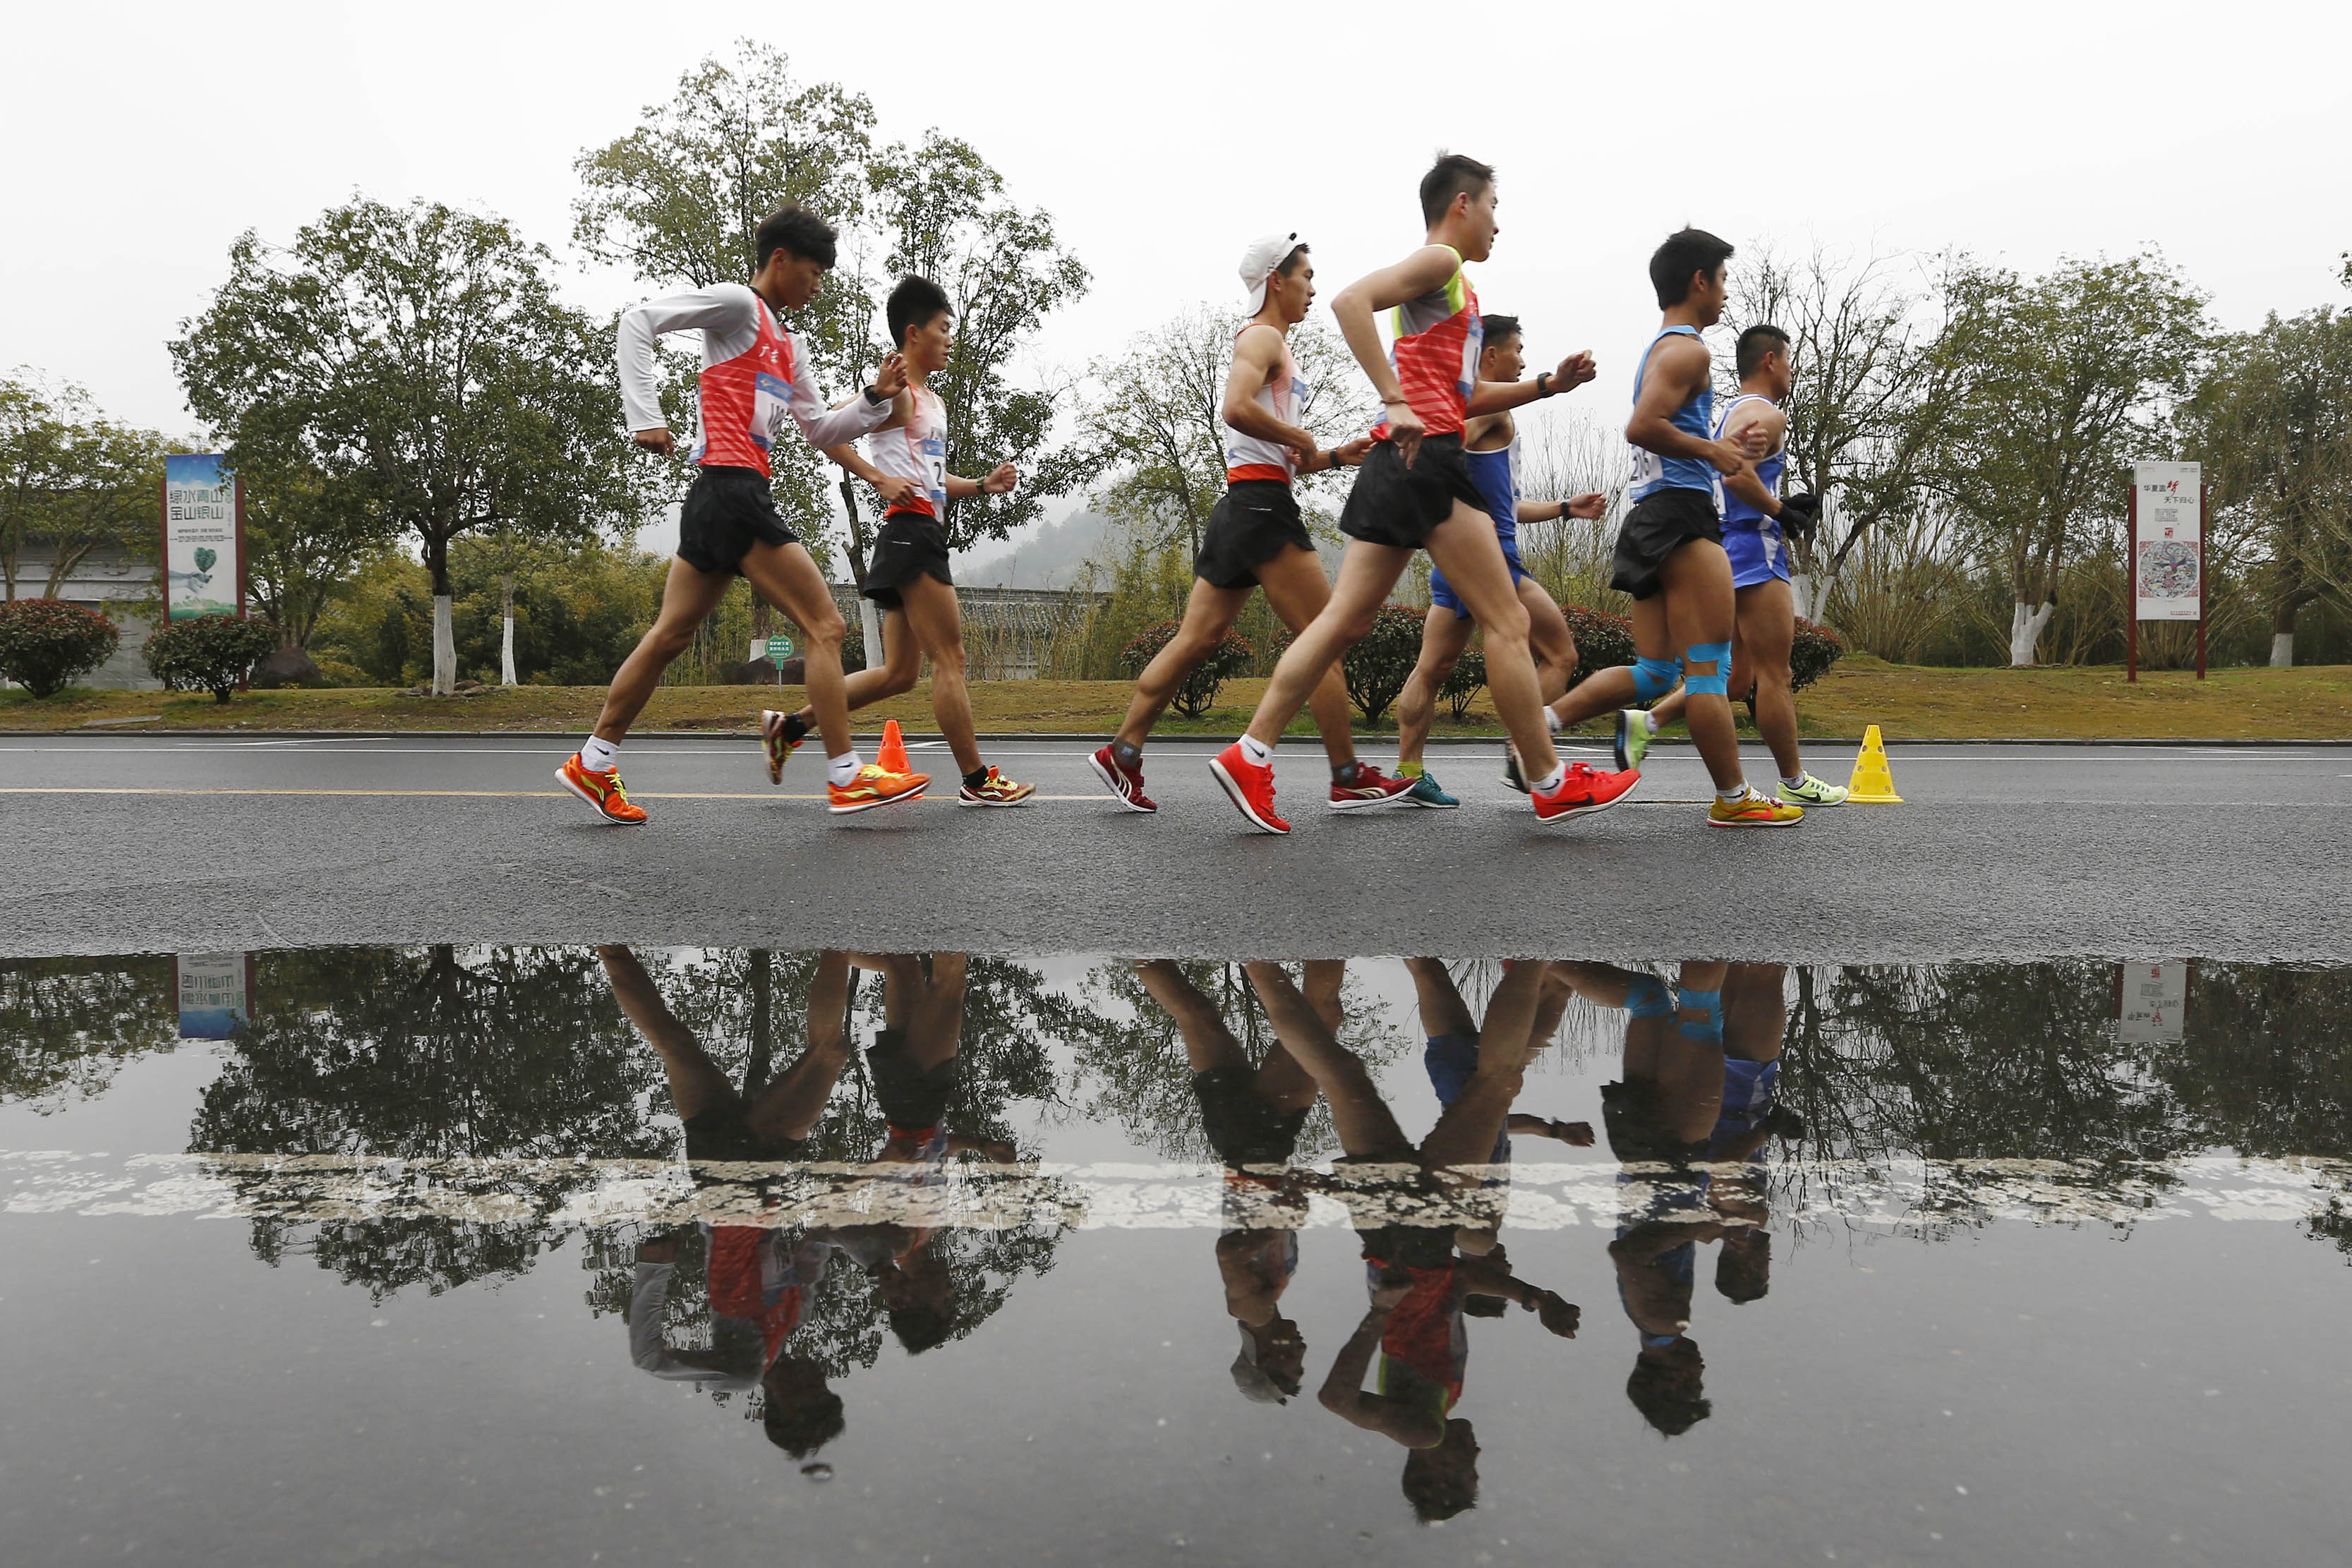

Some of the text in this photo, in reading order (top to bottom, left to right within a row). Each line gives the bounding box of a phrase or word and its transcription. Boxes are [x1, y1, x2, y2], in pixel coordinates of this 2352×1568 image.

[169, 489, 223, 503] 绿水青山
[171, 506, 224, 520] 金山银山
